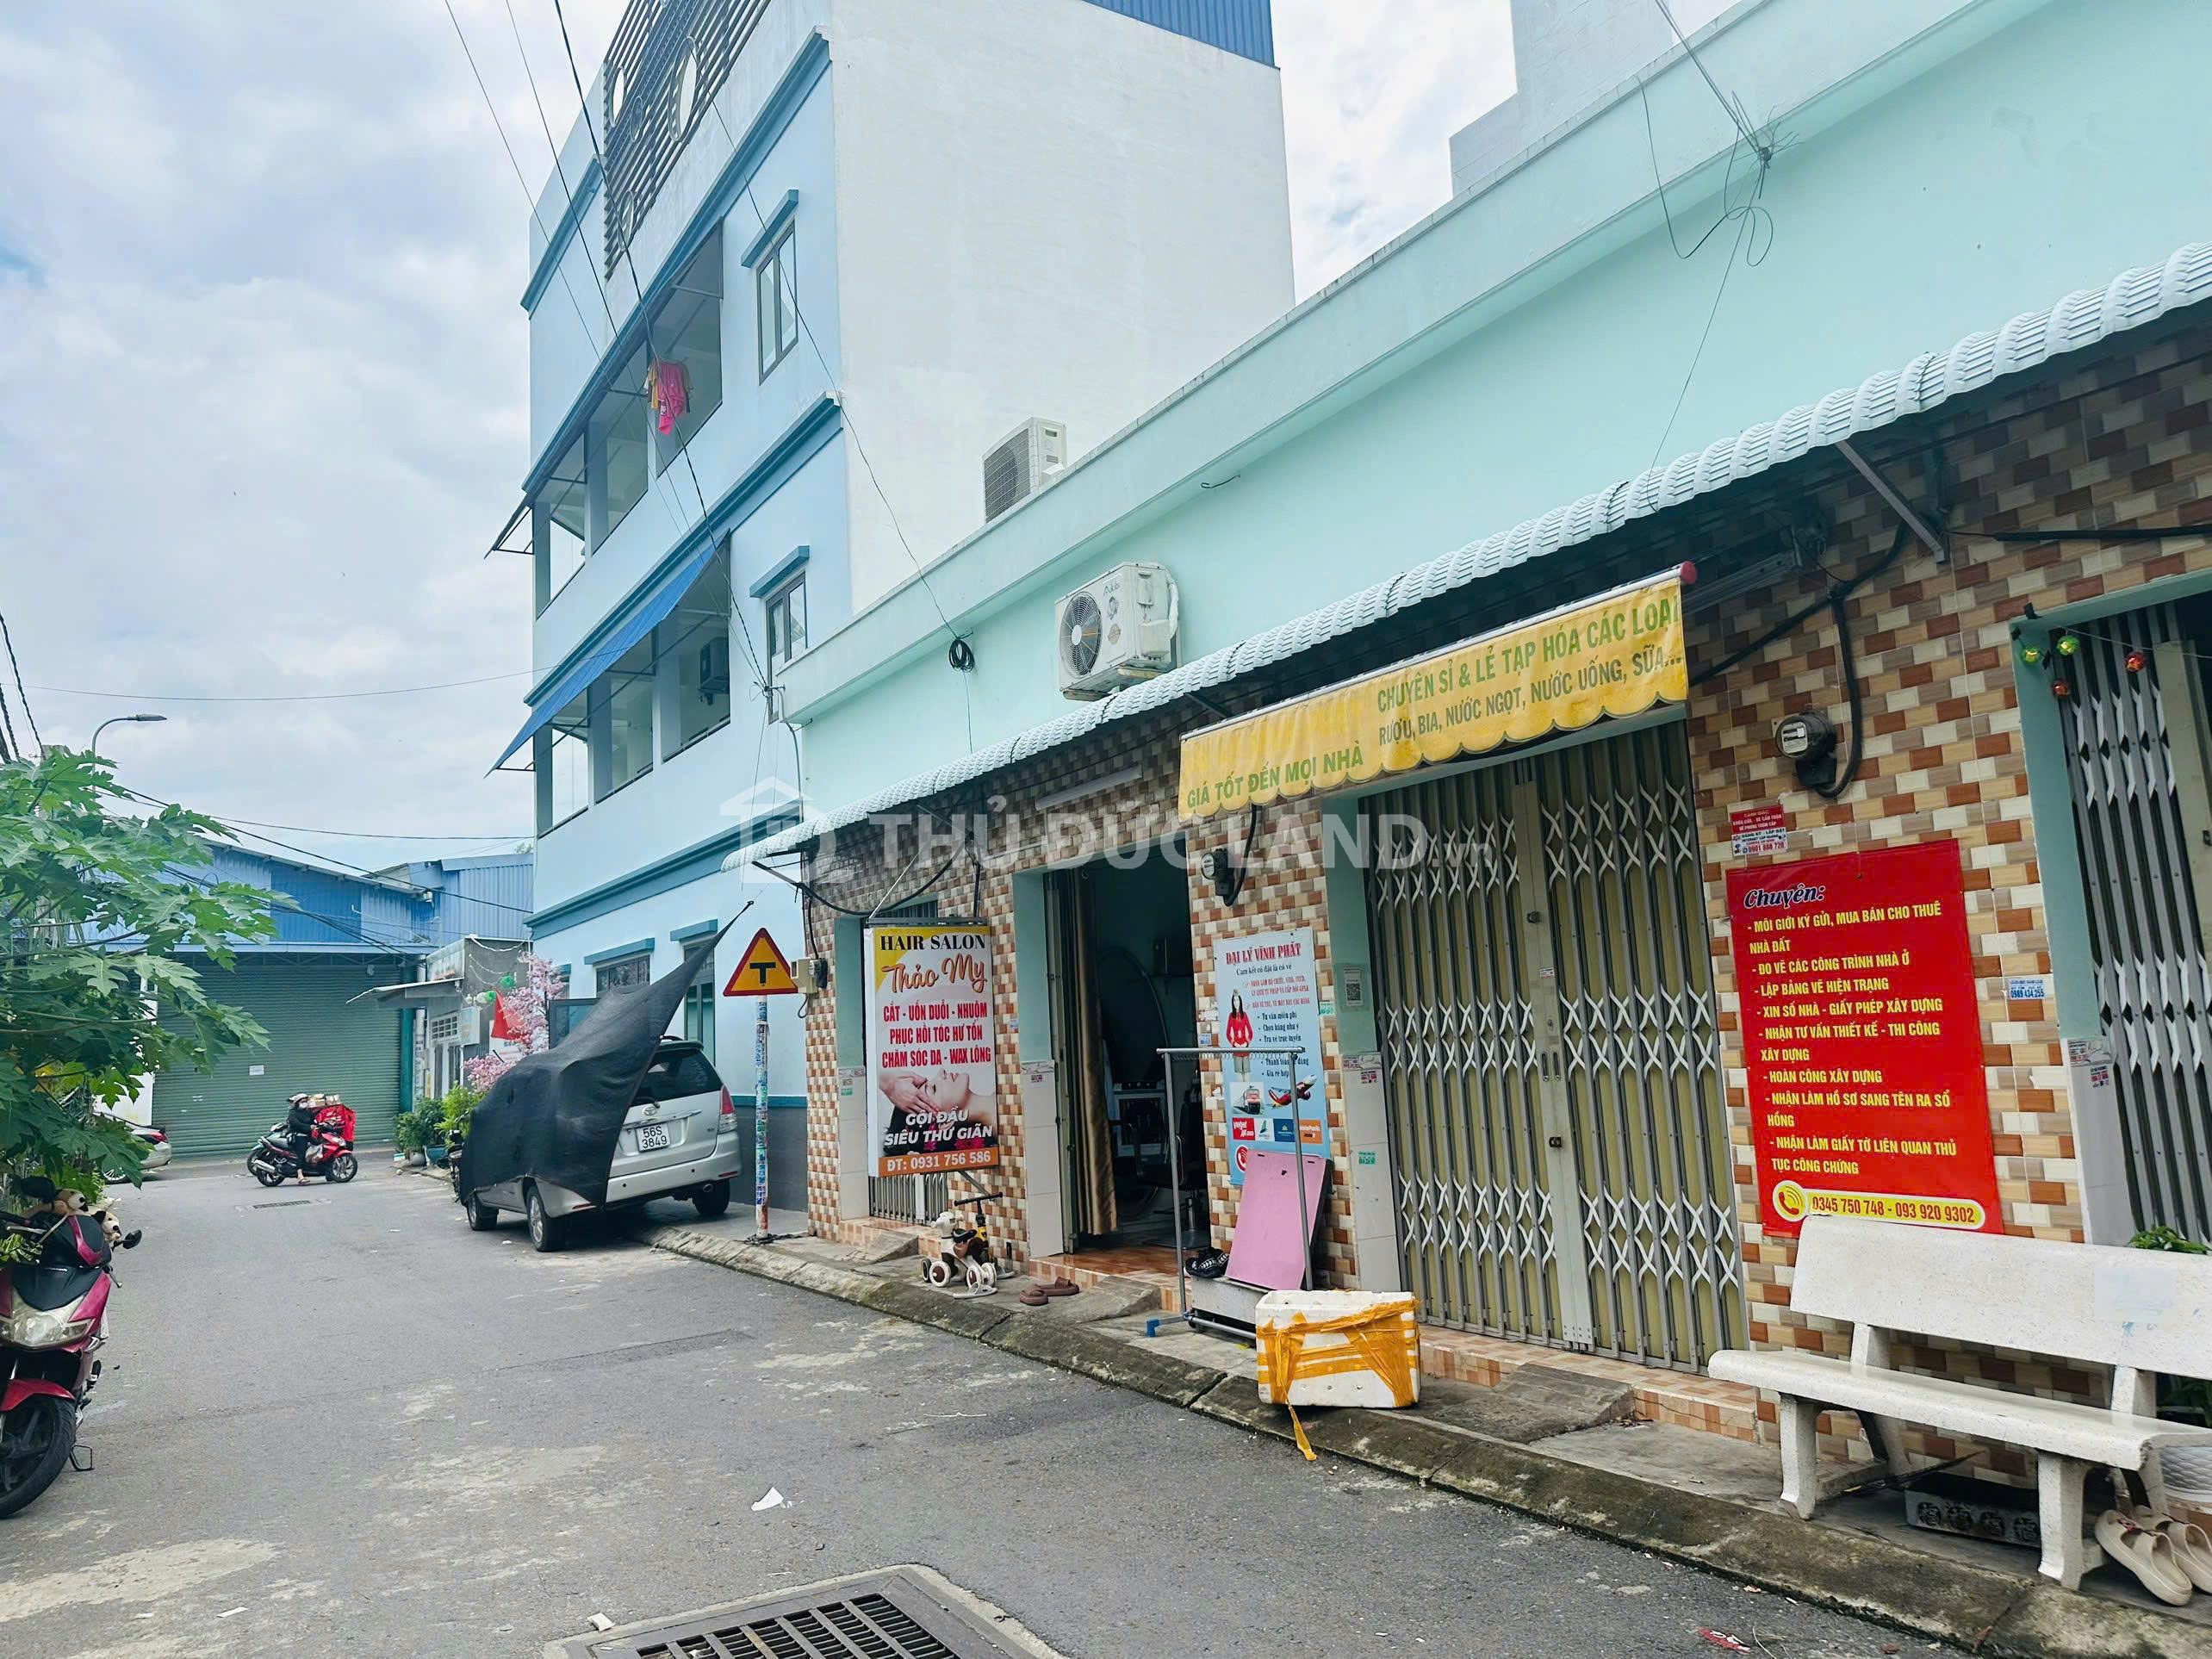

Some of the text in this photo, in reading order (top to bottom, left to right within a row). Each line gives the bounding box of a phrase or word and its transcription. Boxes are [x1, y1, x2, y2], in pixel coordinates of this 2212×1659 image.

[1378, 672, 1433, 713] CHUYÊN
[1439, 659, 1453, 693] SỈ
[1459, 663, 1471, 688] &
[1476, 645, 1496, 683] LẺ
[1502, 641, 1535, 675] TẠP
[1544, 624, 1581, 662] HÓA
[1587, 610, 1626, 648] CÁC
[1418, 711, 1442, 735] BIA,
[1445, 696, 1482, 727] NƯỚC
[1486, 687, 1526, 717] NGỌT,
[1530, 670, 1573, 703] NƯỚC
[1578, 655, 1627, 691] UỐNG,
[1187, 740, 1364, 808] GIÁ TỐT ĐẾN MỌI NHÀ
[1743, 882, 1826, 910] Chuyên:
[1754, 918, 1773, 932] MÔI
[1776, 916, 1795, 930] GIỚI
[1797, 913, 1811, 929] KÝ
[1836, 911, 1860, 925] MUA
[1862, 906, 1885, 922] BÁN
[1887, 906, 1910, 920] CHO
[1912, 900, 1942, 917] THUÊ
[880, 934, 985, 951] HAIR SALON
[1226, 941, 1301, 965] ĐẠI LÝ VĨNH PHÁT
[1749, 936, 1791, 954] NHÀ ĐẤT
[1759, 948, 1910, 975] ĐO VẼ CÁC CÔNG TRÌNH NHÀ Ở
[881, 953, 987, 993] Thảo My
[1761, 978, 1889, 998] LẬP BẢNG VẼ HIỆN TRẠNG
[884, 1001, 900, 1022] CẮT
[909, 999, 926, 1021] UỐN
[958, 1000, 987, 1020] NHUỘM
[1763, 997, 1943, 1018] XIN SỐ NHÀ GIẤY PHÉP XÂY DỰNG
[890, 1028, 913, 1047] PHỤC
[934, 1024, 949, 1042] TÓC
[953, 1023, 965, 1041] HƯ
[1764, 1021, 1940, 1041] NHẬN TƯ VẤN THIẾT KẾ THI CÔNG
[882, 1045, 991, 1068] CHĂM SÓC DA WAX LÔNG
[1761, 1047, 1809, 1063] XÂY DỰNG
[1769, 1068, 1883, 1085] HOÀN CÔNG XÂY DỰNG
[1771, 1090, 1799, 1108] NHẬN
[1802, 1090, 1824, 1105] LÀM
[1843, 1092, 1857, 1106] SƠ
[1861, 1093, 1890, 1106] SANG
[1892, 1091, 1913, 1106] TÊN
[1916, 1094, 1931, 1107] RA
[1935, 1089, 1950, 1108] SỔ
[906, 1106, 969, 1128] GỘI ĐẦU
[642, 1135, 668, 1149] 3849
[643, 1125, 662, 1137] 56S
[884, 1123, 992, 1146] SIÊU THƯ GIÃN
[1776, 1134, 1957, 1156] NHẬN LÀM GIẤY TỜ LIÊN QUAN THỦ
[887, 1151, 991, 1171] ĐT: 0931 756 586
[1771, 1158, 1859, 1175] TỤC CÔNG CHỨNG
[1812, 1196, 1974, 1223] 0345 750 748 093 920 9302
